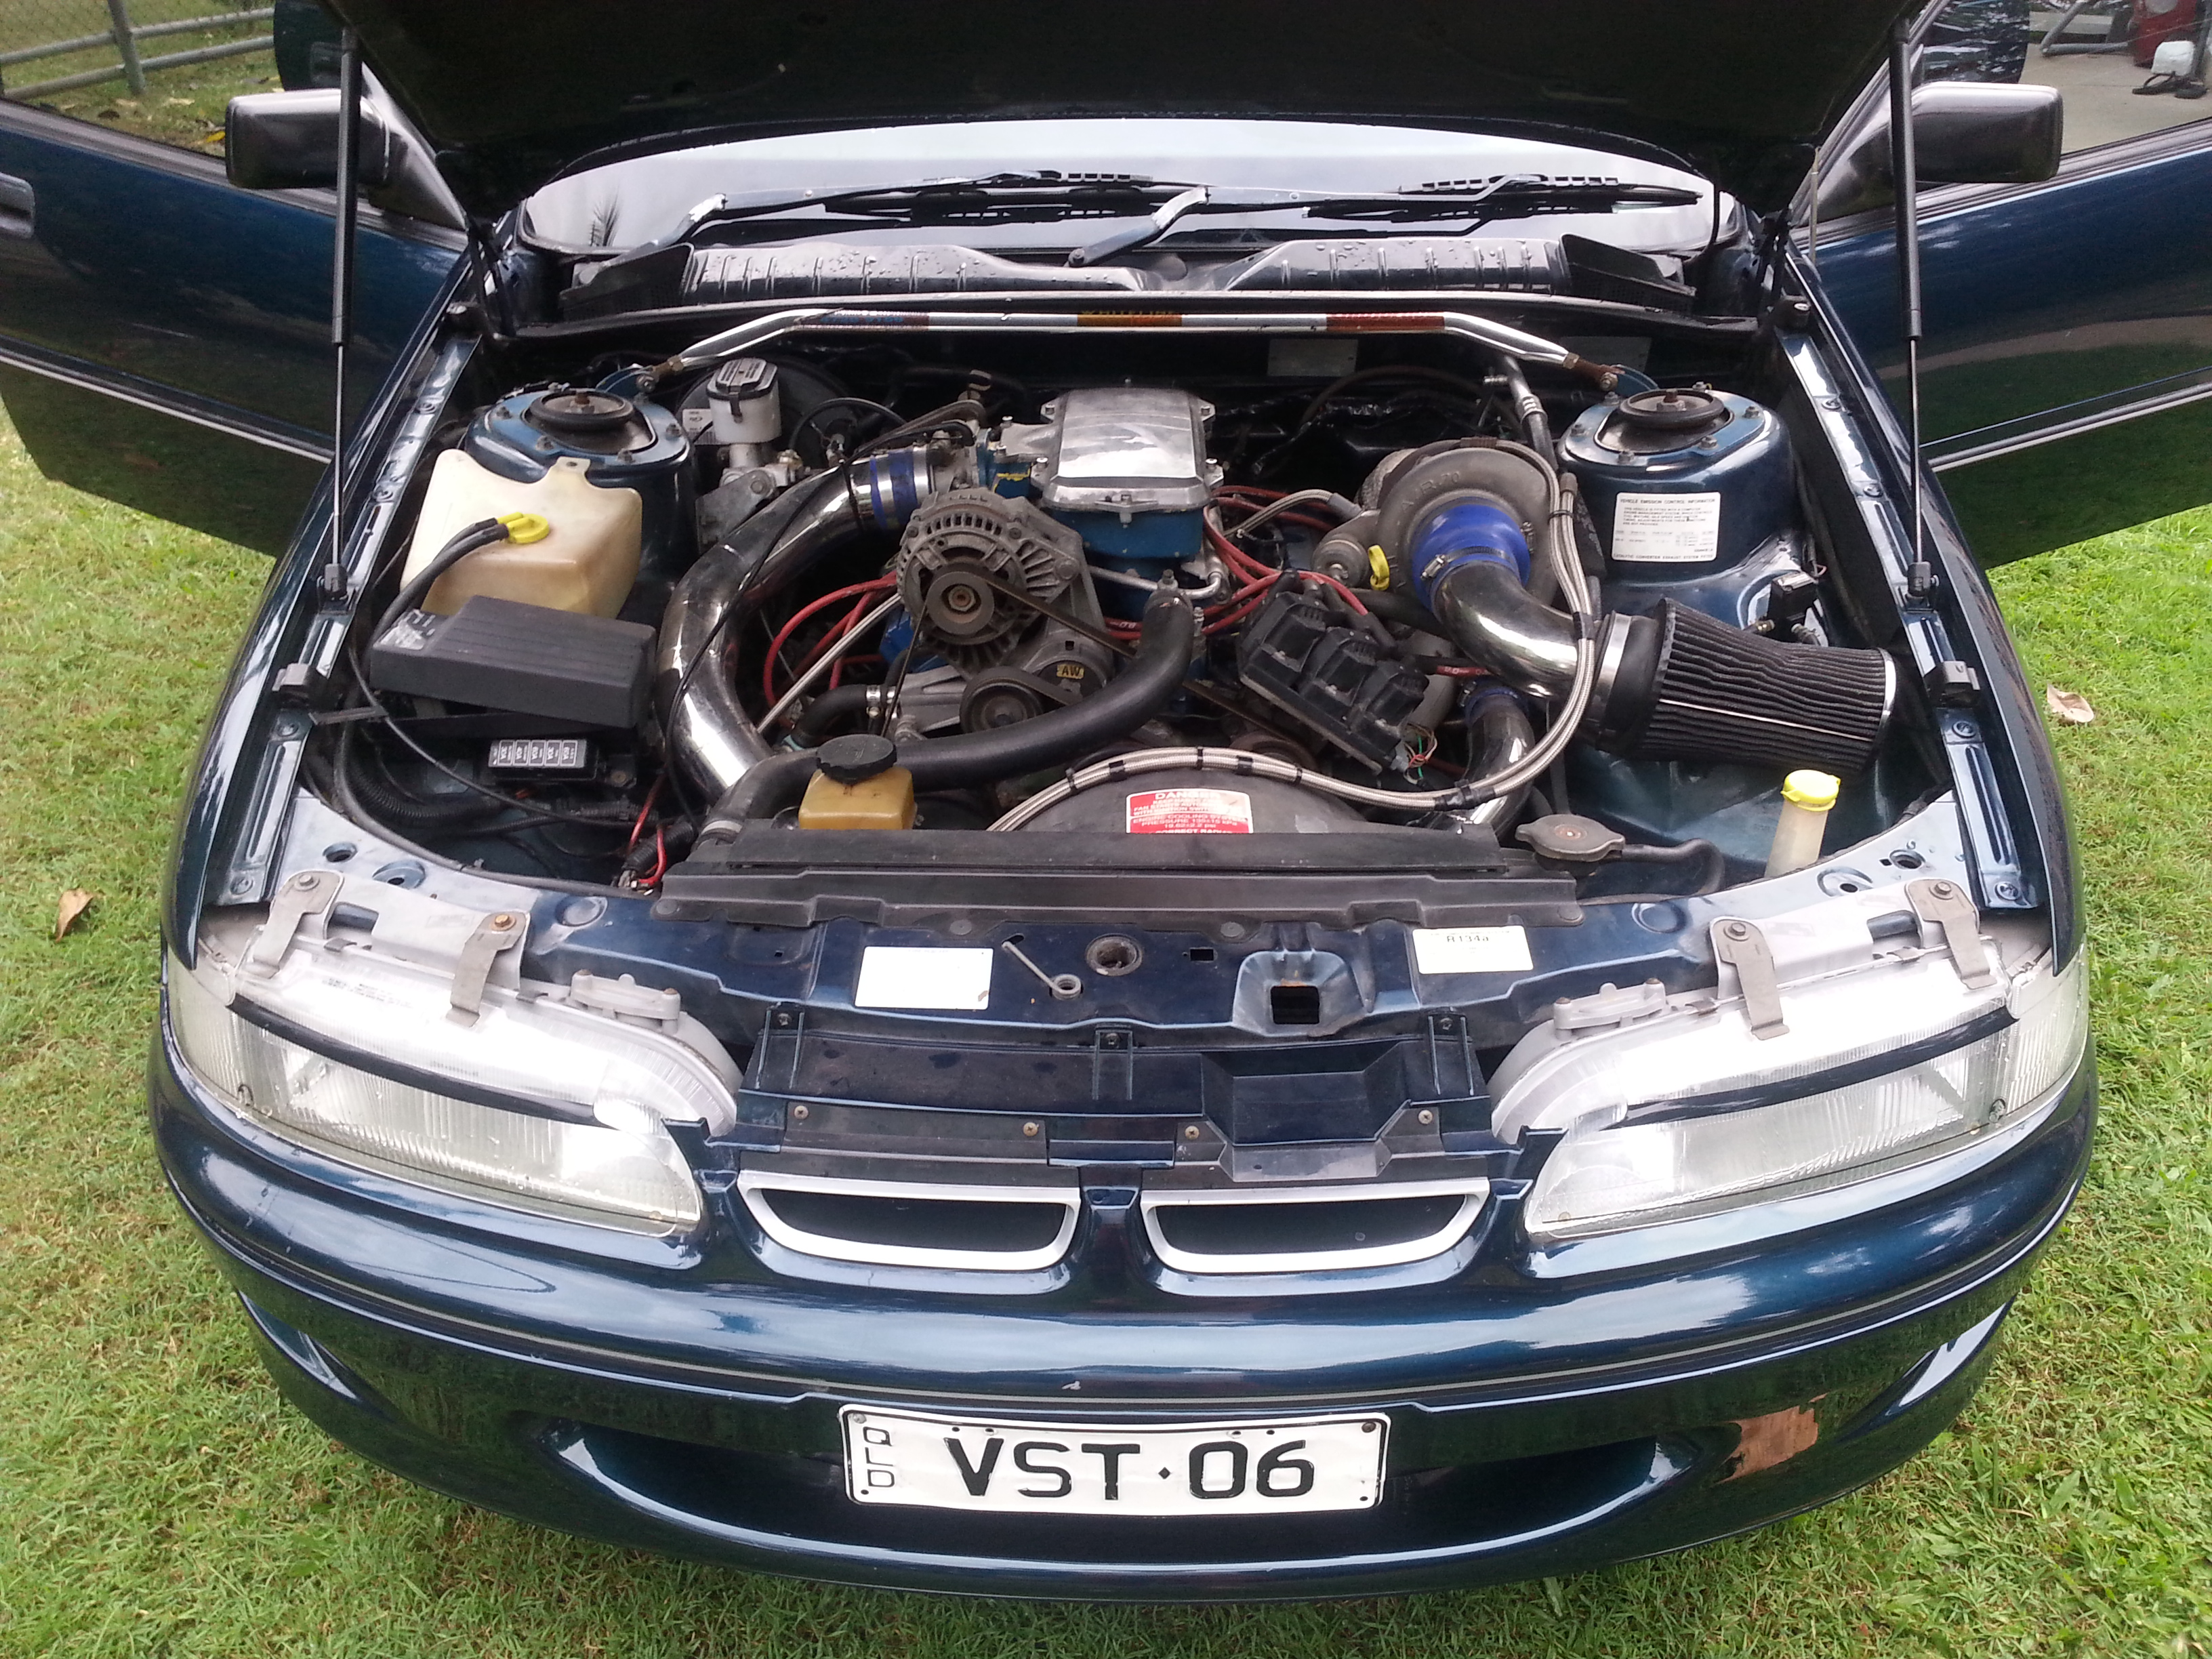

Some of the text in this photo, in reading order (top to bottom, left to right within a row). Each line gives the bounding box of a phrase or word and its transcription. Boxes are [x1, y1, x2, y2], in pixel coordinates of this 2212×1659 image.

[1061, 665, 1082, 676] AW
[1155, 791, 1220, 800] DANGER
[1133, 815, 1165, 824] ENGINE
[1141, 819, 1189, 827] PRESSURE
[1446, 935, 1489, 943] R134a
[943, 1437, 1316, 1500] VST 06
